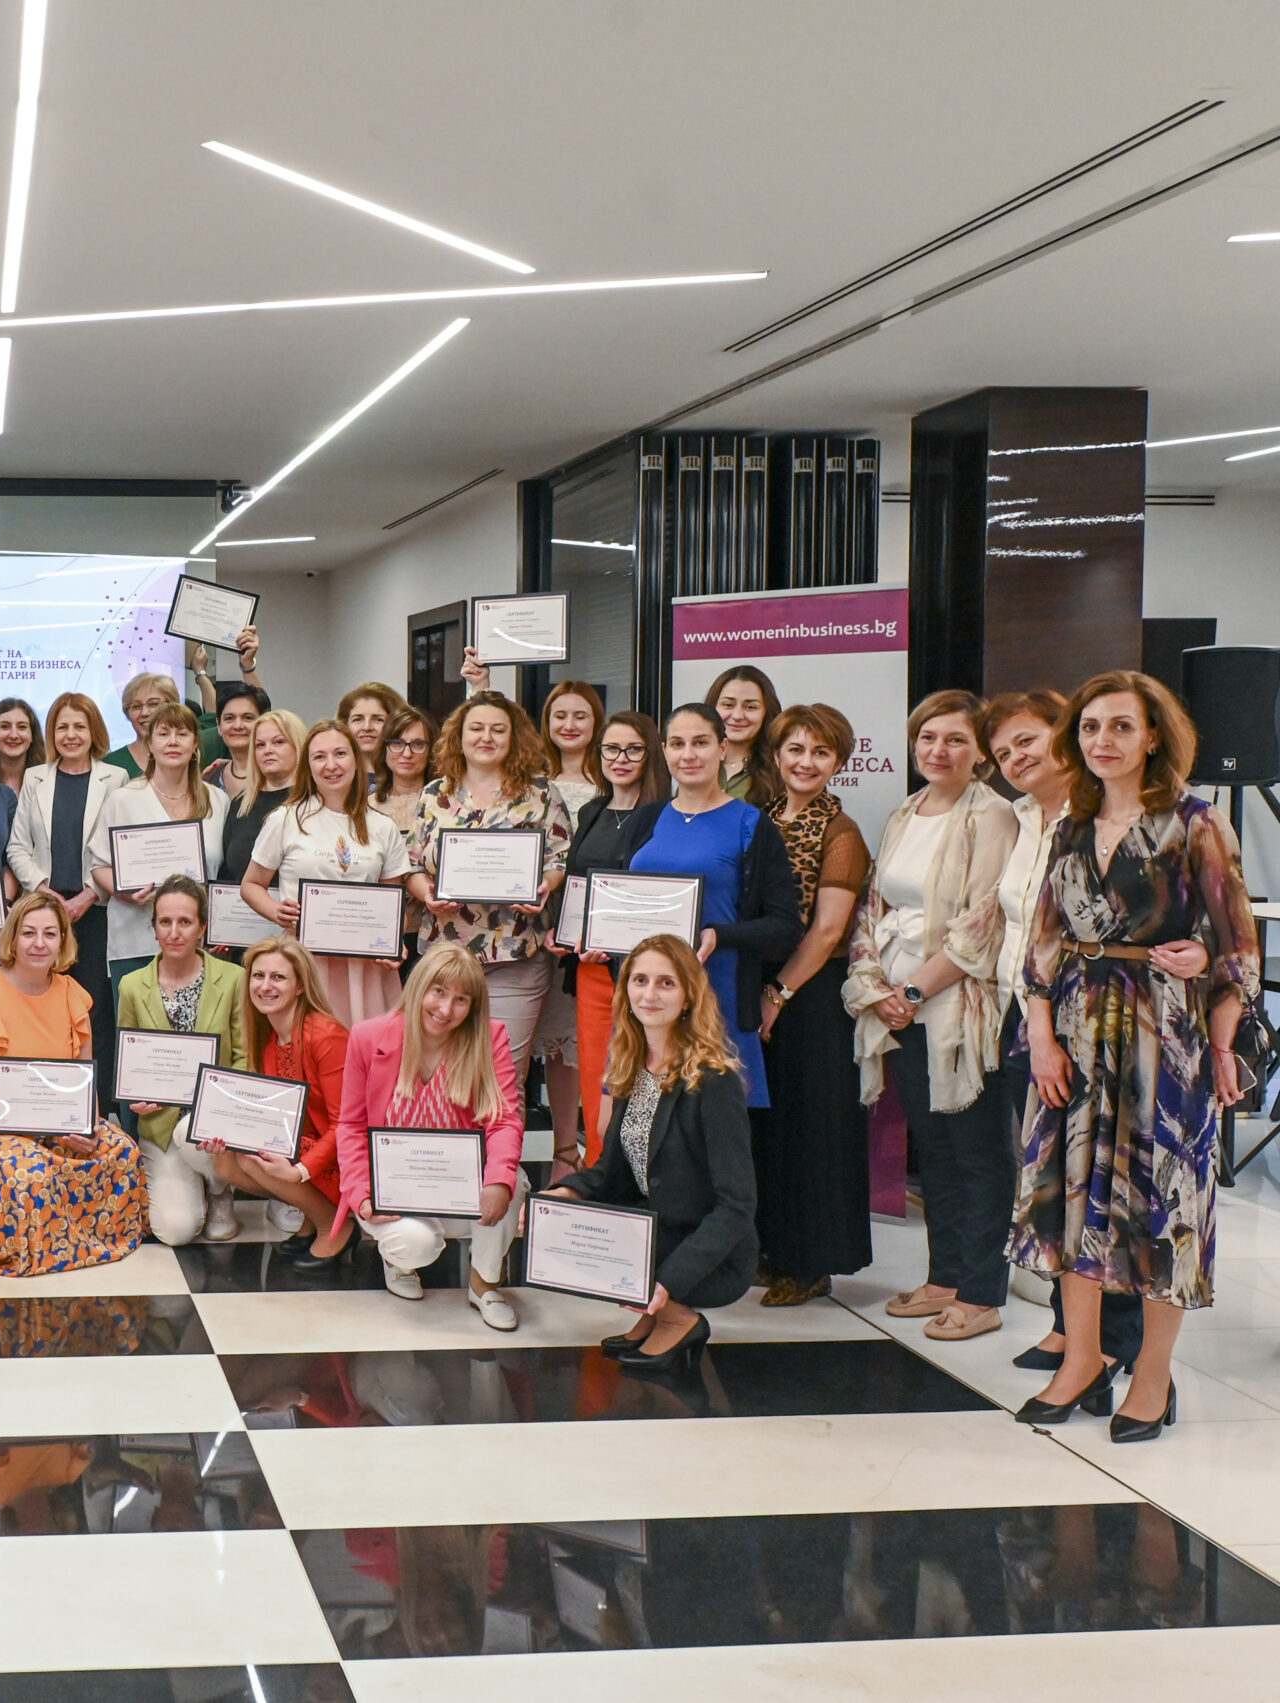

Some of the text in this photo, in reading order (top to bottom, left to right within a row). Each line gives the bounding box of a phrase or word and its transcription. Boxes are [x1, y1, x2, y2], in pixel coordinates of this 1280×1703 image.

[683, 619, 898, 643] www.womeninbusiness.bg
[7, 649, 23, 658] НА
[20, 660, 27, 669] В
[30, 660, 82, 669] БИЗНЕСА
[571, 1223, 609, 1235] СЕРТИФИКАТ
